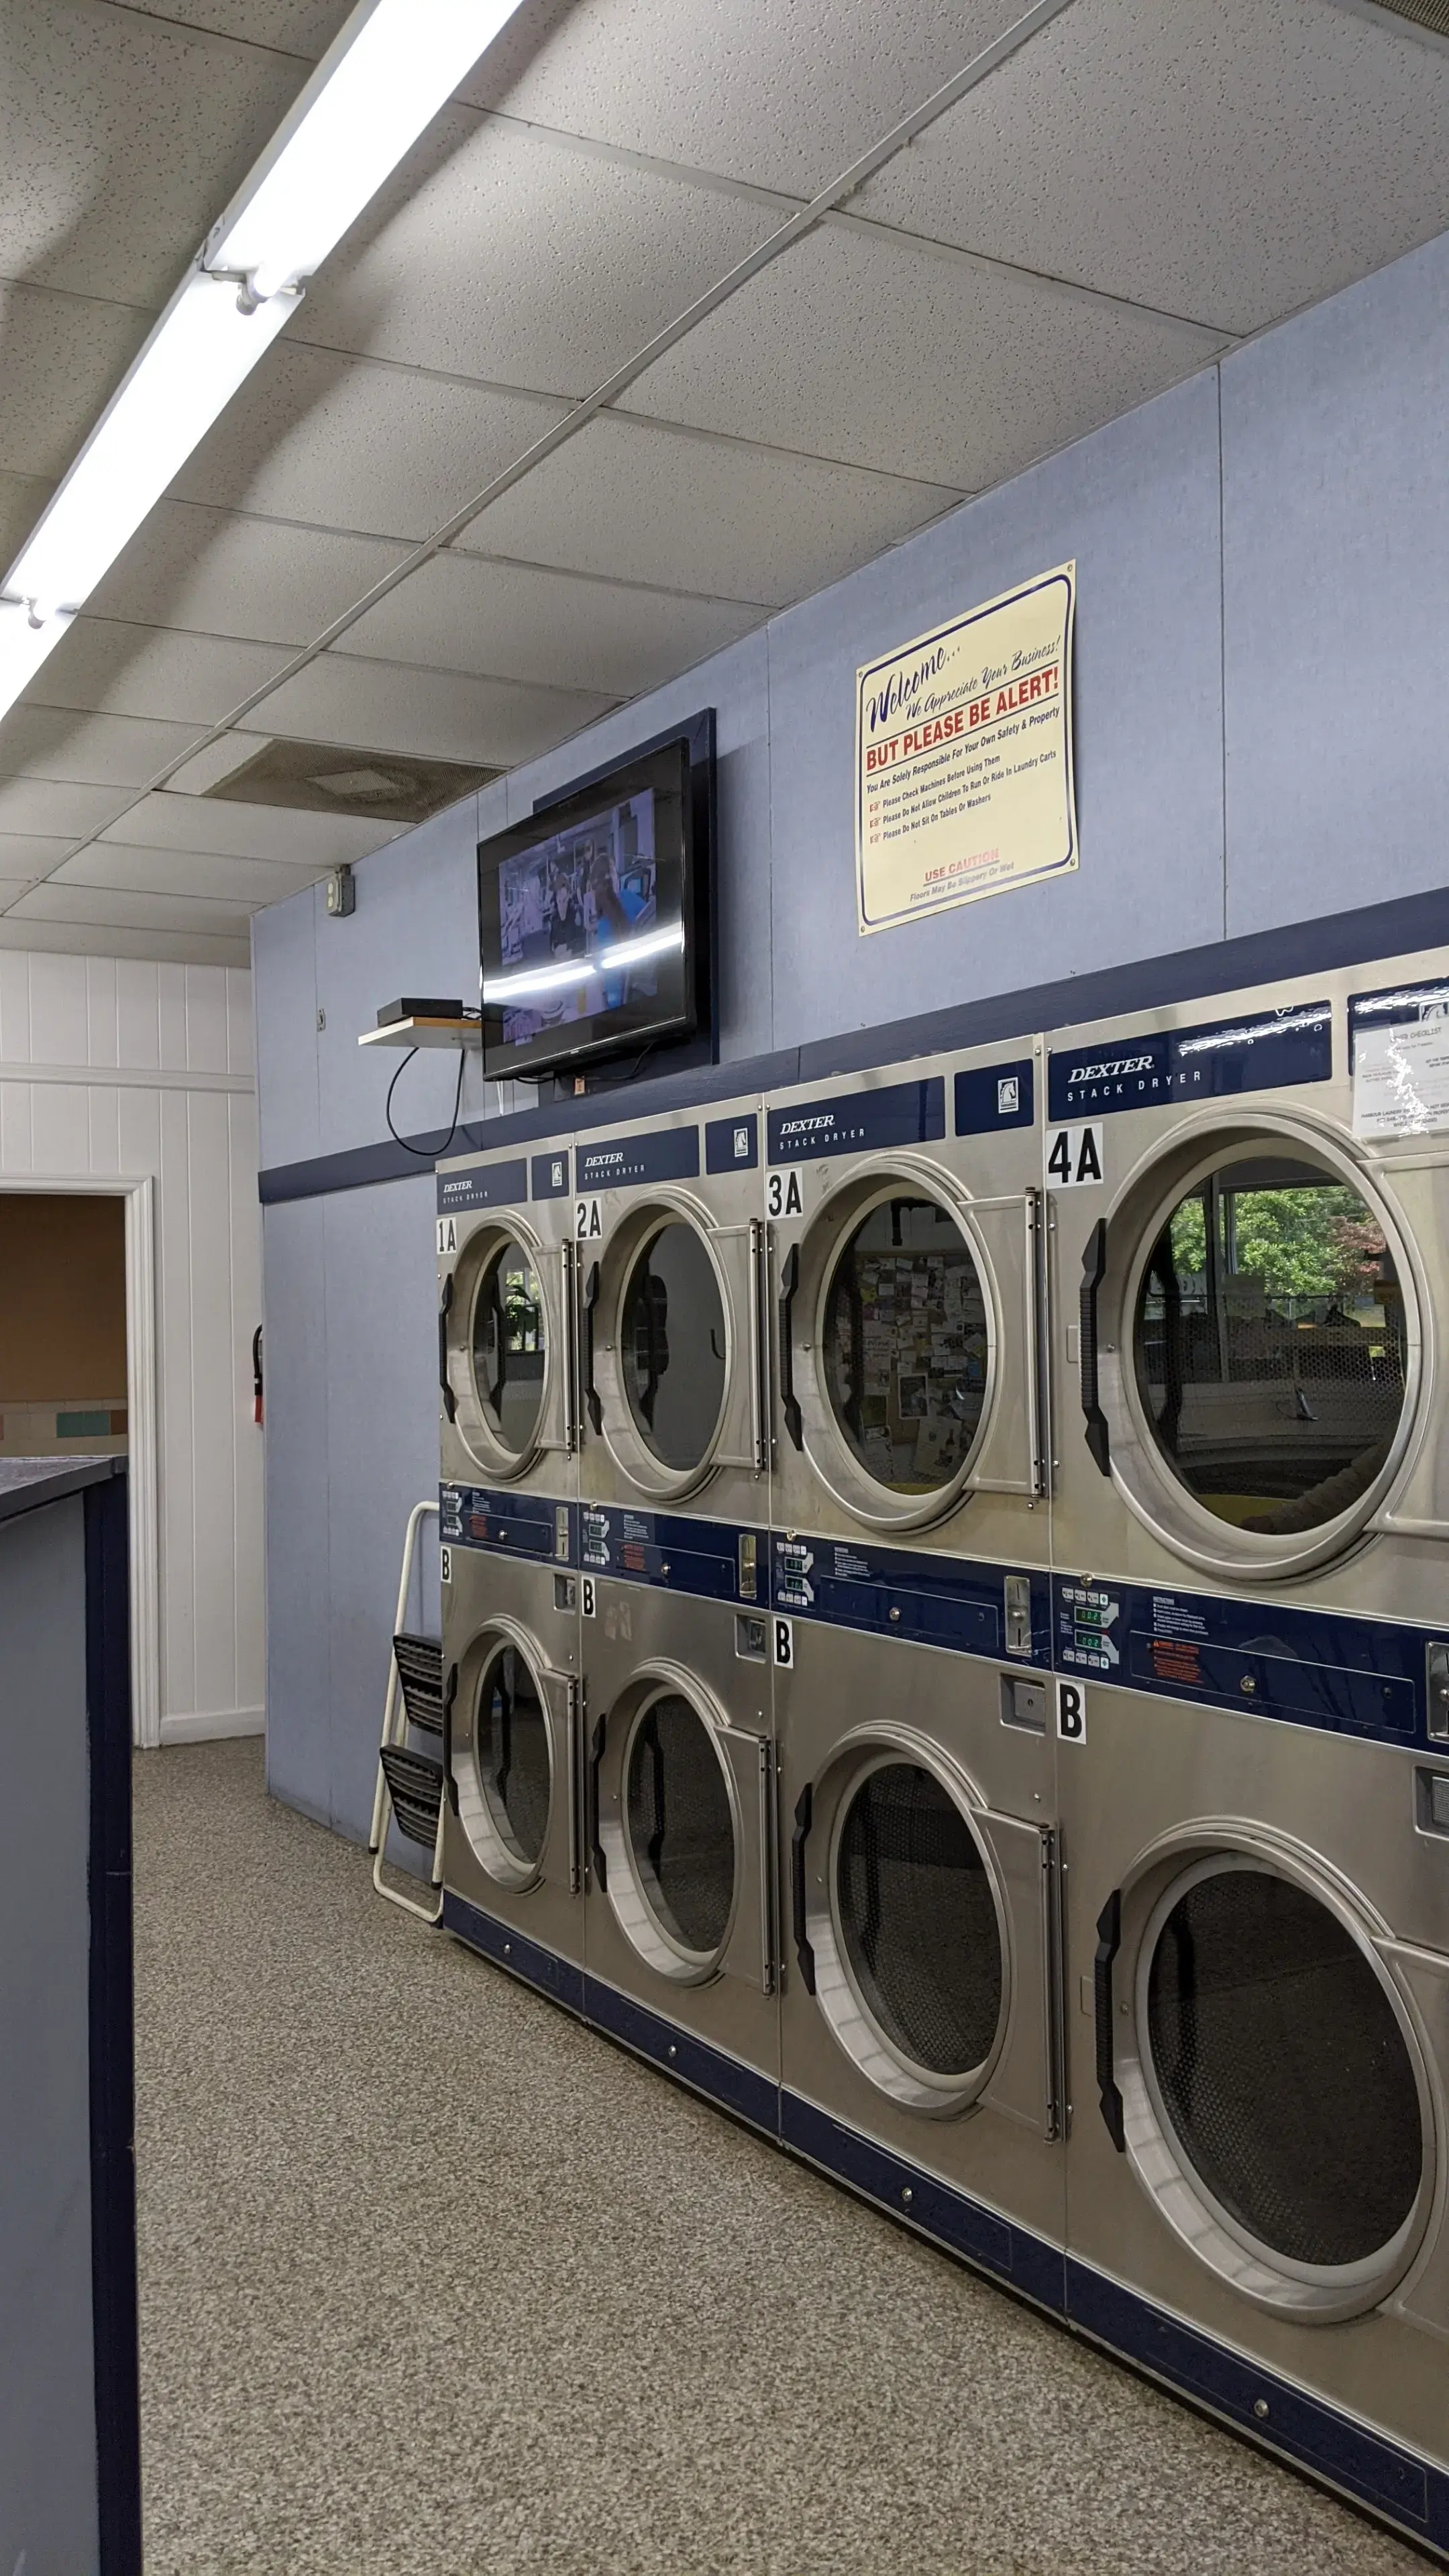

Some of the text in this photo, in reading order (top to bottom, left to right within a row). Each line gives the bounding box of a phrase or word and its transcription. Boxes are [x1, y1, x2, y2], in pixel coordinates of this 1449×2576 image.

[906, 635, 1061, 720] We Appreciate Your Business!
[867, 666, 1058, 771] BUT PLEASE BE ALERT!
[867, 707, 1060, 794] You Are Solely Responsible For Your Own Safety & Property
[883, 755, 1000, 808] Please Check Machines Before Using Them
[883, 750, 1057, 824] Please Do Not Allow Children To Run Or Ride In Laundry Carts
[883, 794, 991, 840] Please Do Not Sit On Tables Or Washers
[910, 861, 1014, 902] Floors May Be Slippery Or Wet
[925, 848, 1000, 881] USE CAUTION
[1410, 1026, 1442, 1038] CHECKLIST
[1067, 1071, 1201, 1102] STACK DRYER
[1068, 1055, 1152, 1083] DEXTER
[780, 1114, 835, 1134] DEXTER
[1382, 1108, 1402, 1116] LAUNDRY
[780, 1128, 864, 1150] STACK DRYER
[1048, 1127, 1102, 1183] 4A
[585, 1152, 624, 1167] DEXTER
[585, 1165, 644, 1180] STACK DRYER
[443, 1180, 472, 1193] DEXTER
[443, 1191, 488, 1204] STACK DRYER
[769, 1171, 802, 1216] 3A
[439, 1220, 456, 1252] 1A
[577, 1200, 601, 1238] 2A
[442, 1548, 449, 1580] B
[584, 1578, 594, 1615] B
[775, 1619, 791, 1664] B
[1059, 1683, 1082, 1738] B
